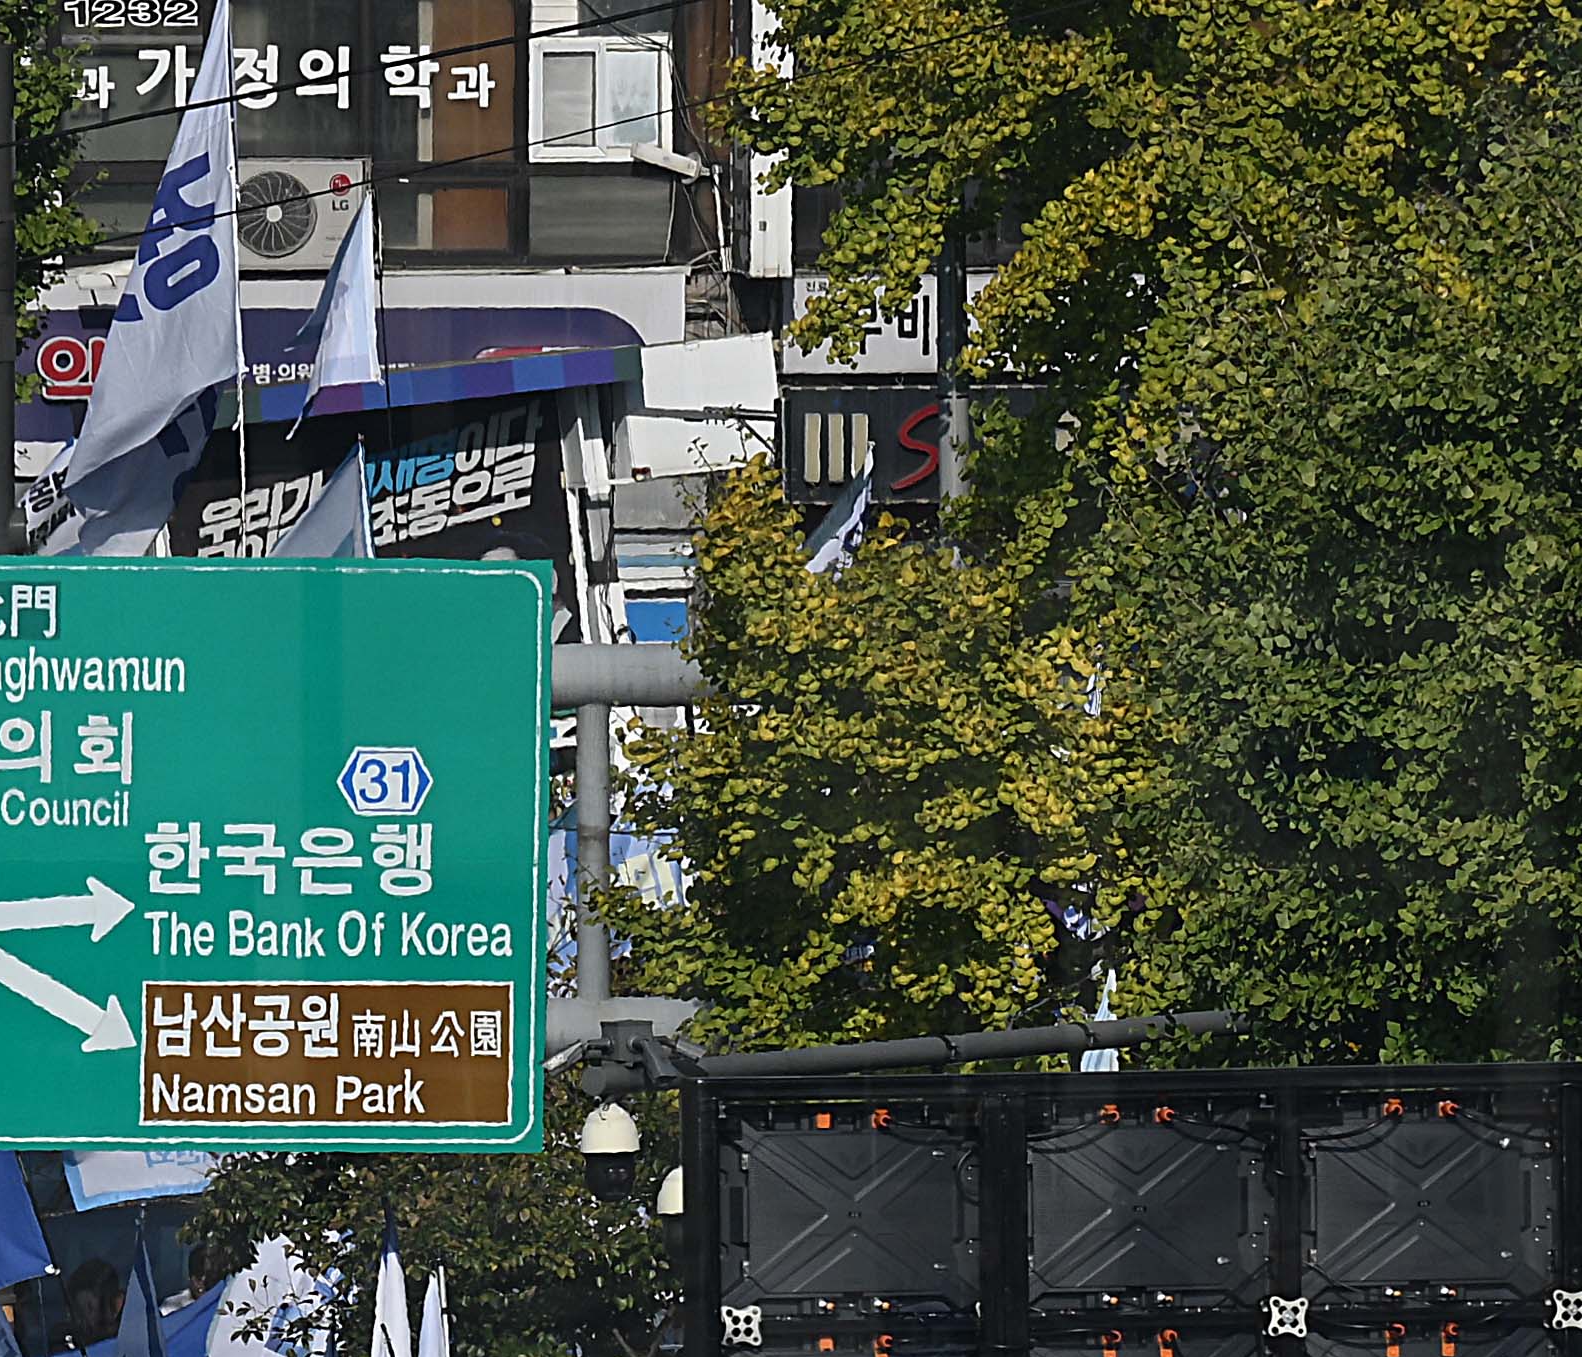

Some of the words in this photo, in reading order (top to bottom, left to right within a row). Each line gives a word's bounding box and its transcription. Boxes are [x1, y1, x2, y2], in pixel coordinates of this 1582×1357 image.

[332, 199, 350, 211] LG
[357, 757, 415, 805] 31
[1, 788, 130, 828] Council
[145, 822, 433, 897] 한국은행
[145, 912, 218, 958] The
[229, 910, 325, 958] Bank
[340, 911, 385, 958] Of
[401, 912, 512, 958] Korea
[154, 996, 338, 1061] 남산공원
[352, 1010, 502, 1061] 南山公園
[152, 1074, 314, 1116] Namsan
[335, 1073, 425, 1116] Park
